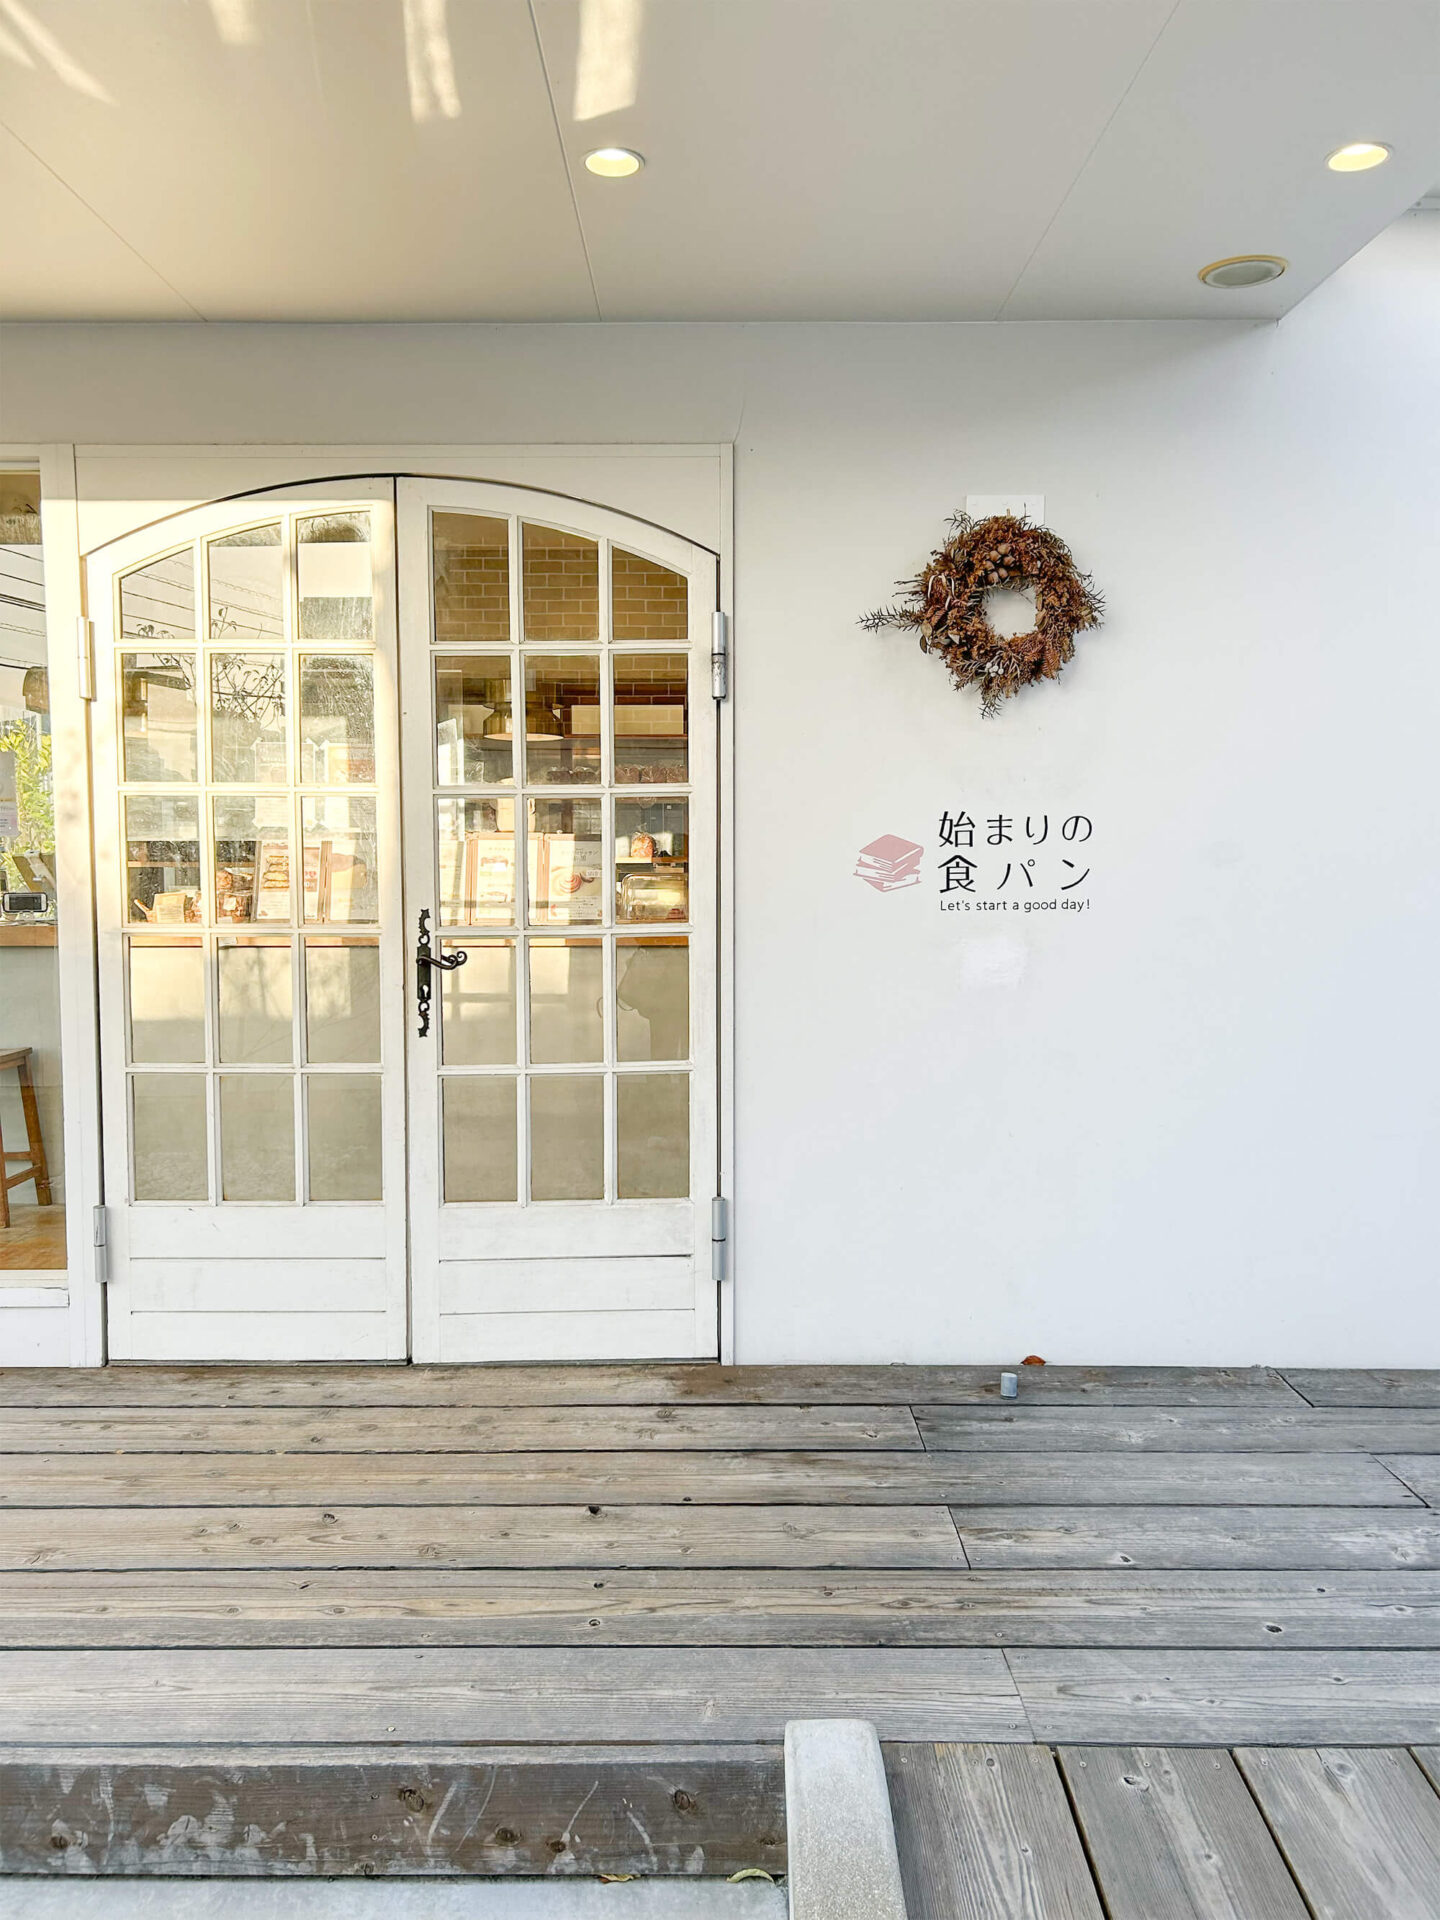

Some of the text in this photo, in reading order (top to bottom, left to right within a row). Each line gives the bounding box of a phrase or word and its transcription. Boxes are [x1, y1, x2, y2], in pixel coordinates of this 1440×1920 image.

[938, 811, 1093, 848] 始まりの
[937, 854, 1091, 894] 食パン
[940, 898, 1090, 913] Let's start a good day!
